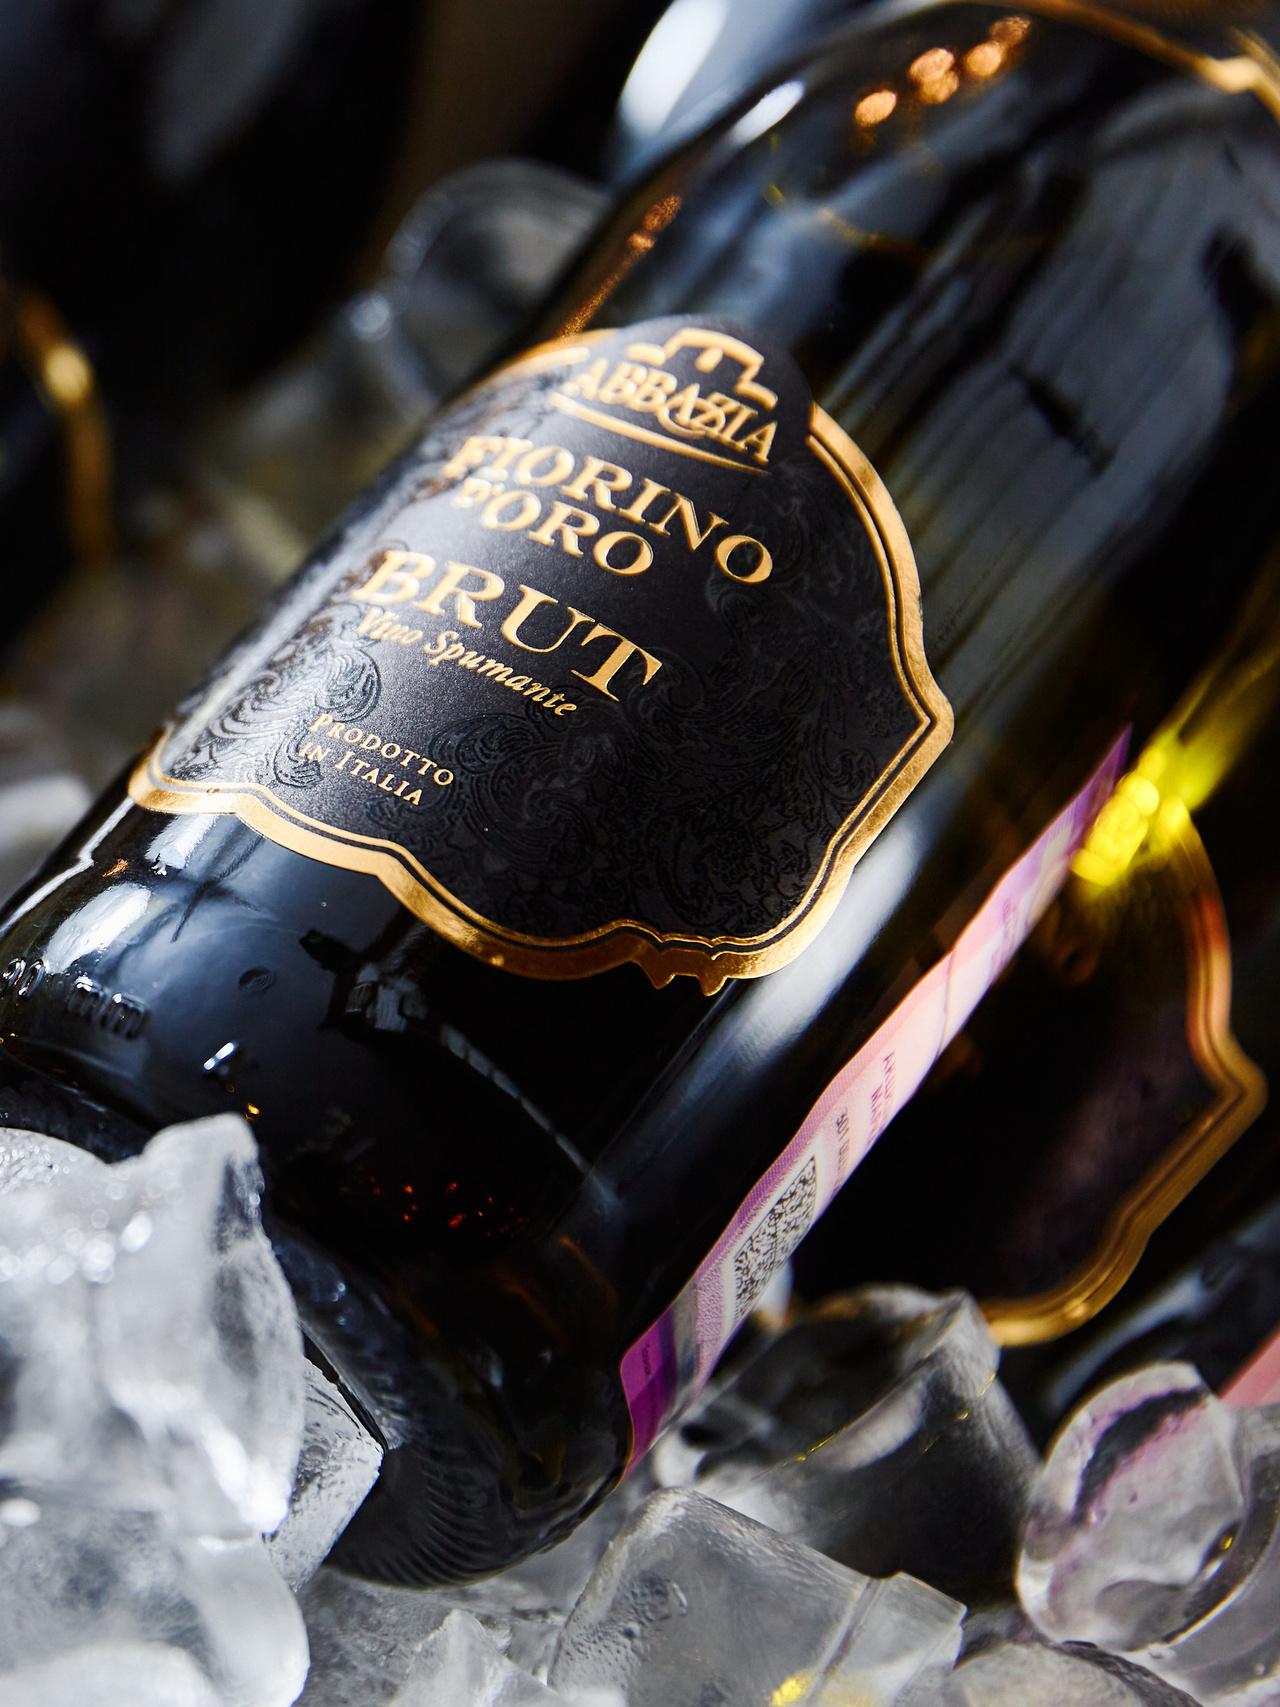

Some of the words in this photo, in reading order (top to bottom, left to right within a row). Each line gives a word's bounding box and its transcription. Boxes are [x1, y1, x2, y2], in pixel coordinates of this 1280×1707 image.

[560, 358, 778, 466] ABBAZIA
[443, 437, 773, 584] FIORINO
[451, 478, 654, 576] D'ORO
[351, 549, 662, 701] BRUT
[357, 608, 423, 645] Vino
[424, 631, 578, 716] Spumante
[298, 742, 331, 764] IN
[335, 750, 424, 806] ITALIA
[309, 713, 455, 787] PRODOTTO
